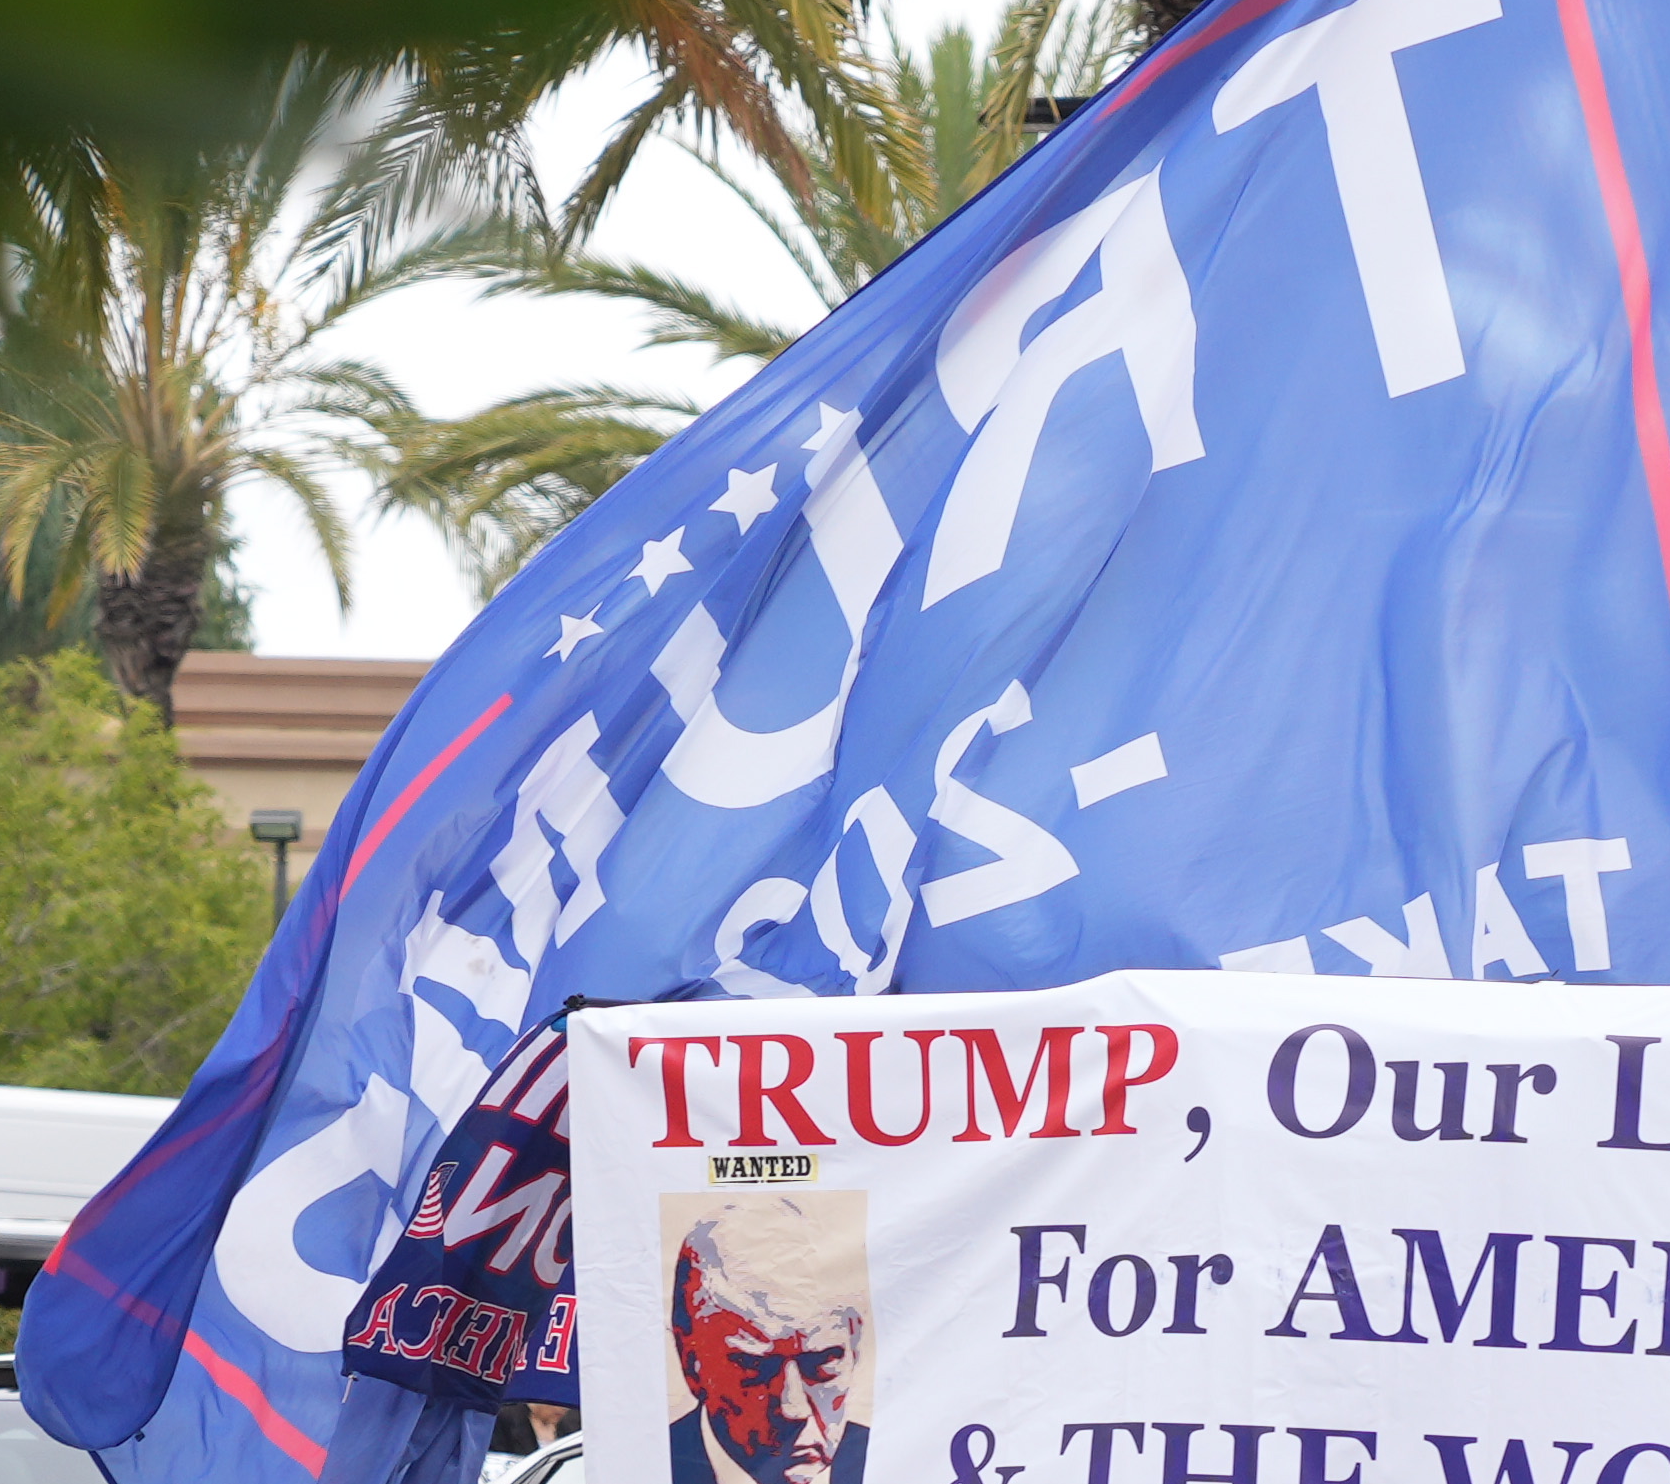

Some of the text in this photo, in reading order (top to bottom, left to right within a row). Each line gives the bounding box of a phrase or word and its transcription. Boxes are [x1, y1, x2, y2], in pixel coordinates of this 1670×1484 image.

[628, 1023, 1211, 1163] TRUMP,
[1267, 1023, 1557, 1145] Our
[712, 1154, 812, 1178] WANTED
[1002, 1224, 1234, 1338] For
